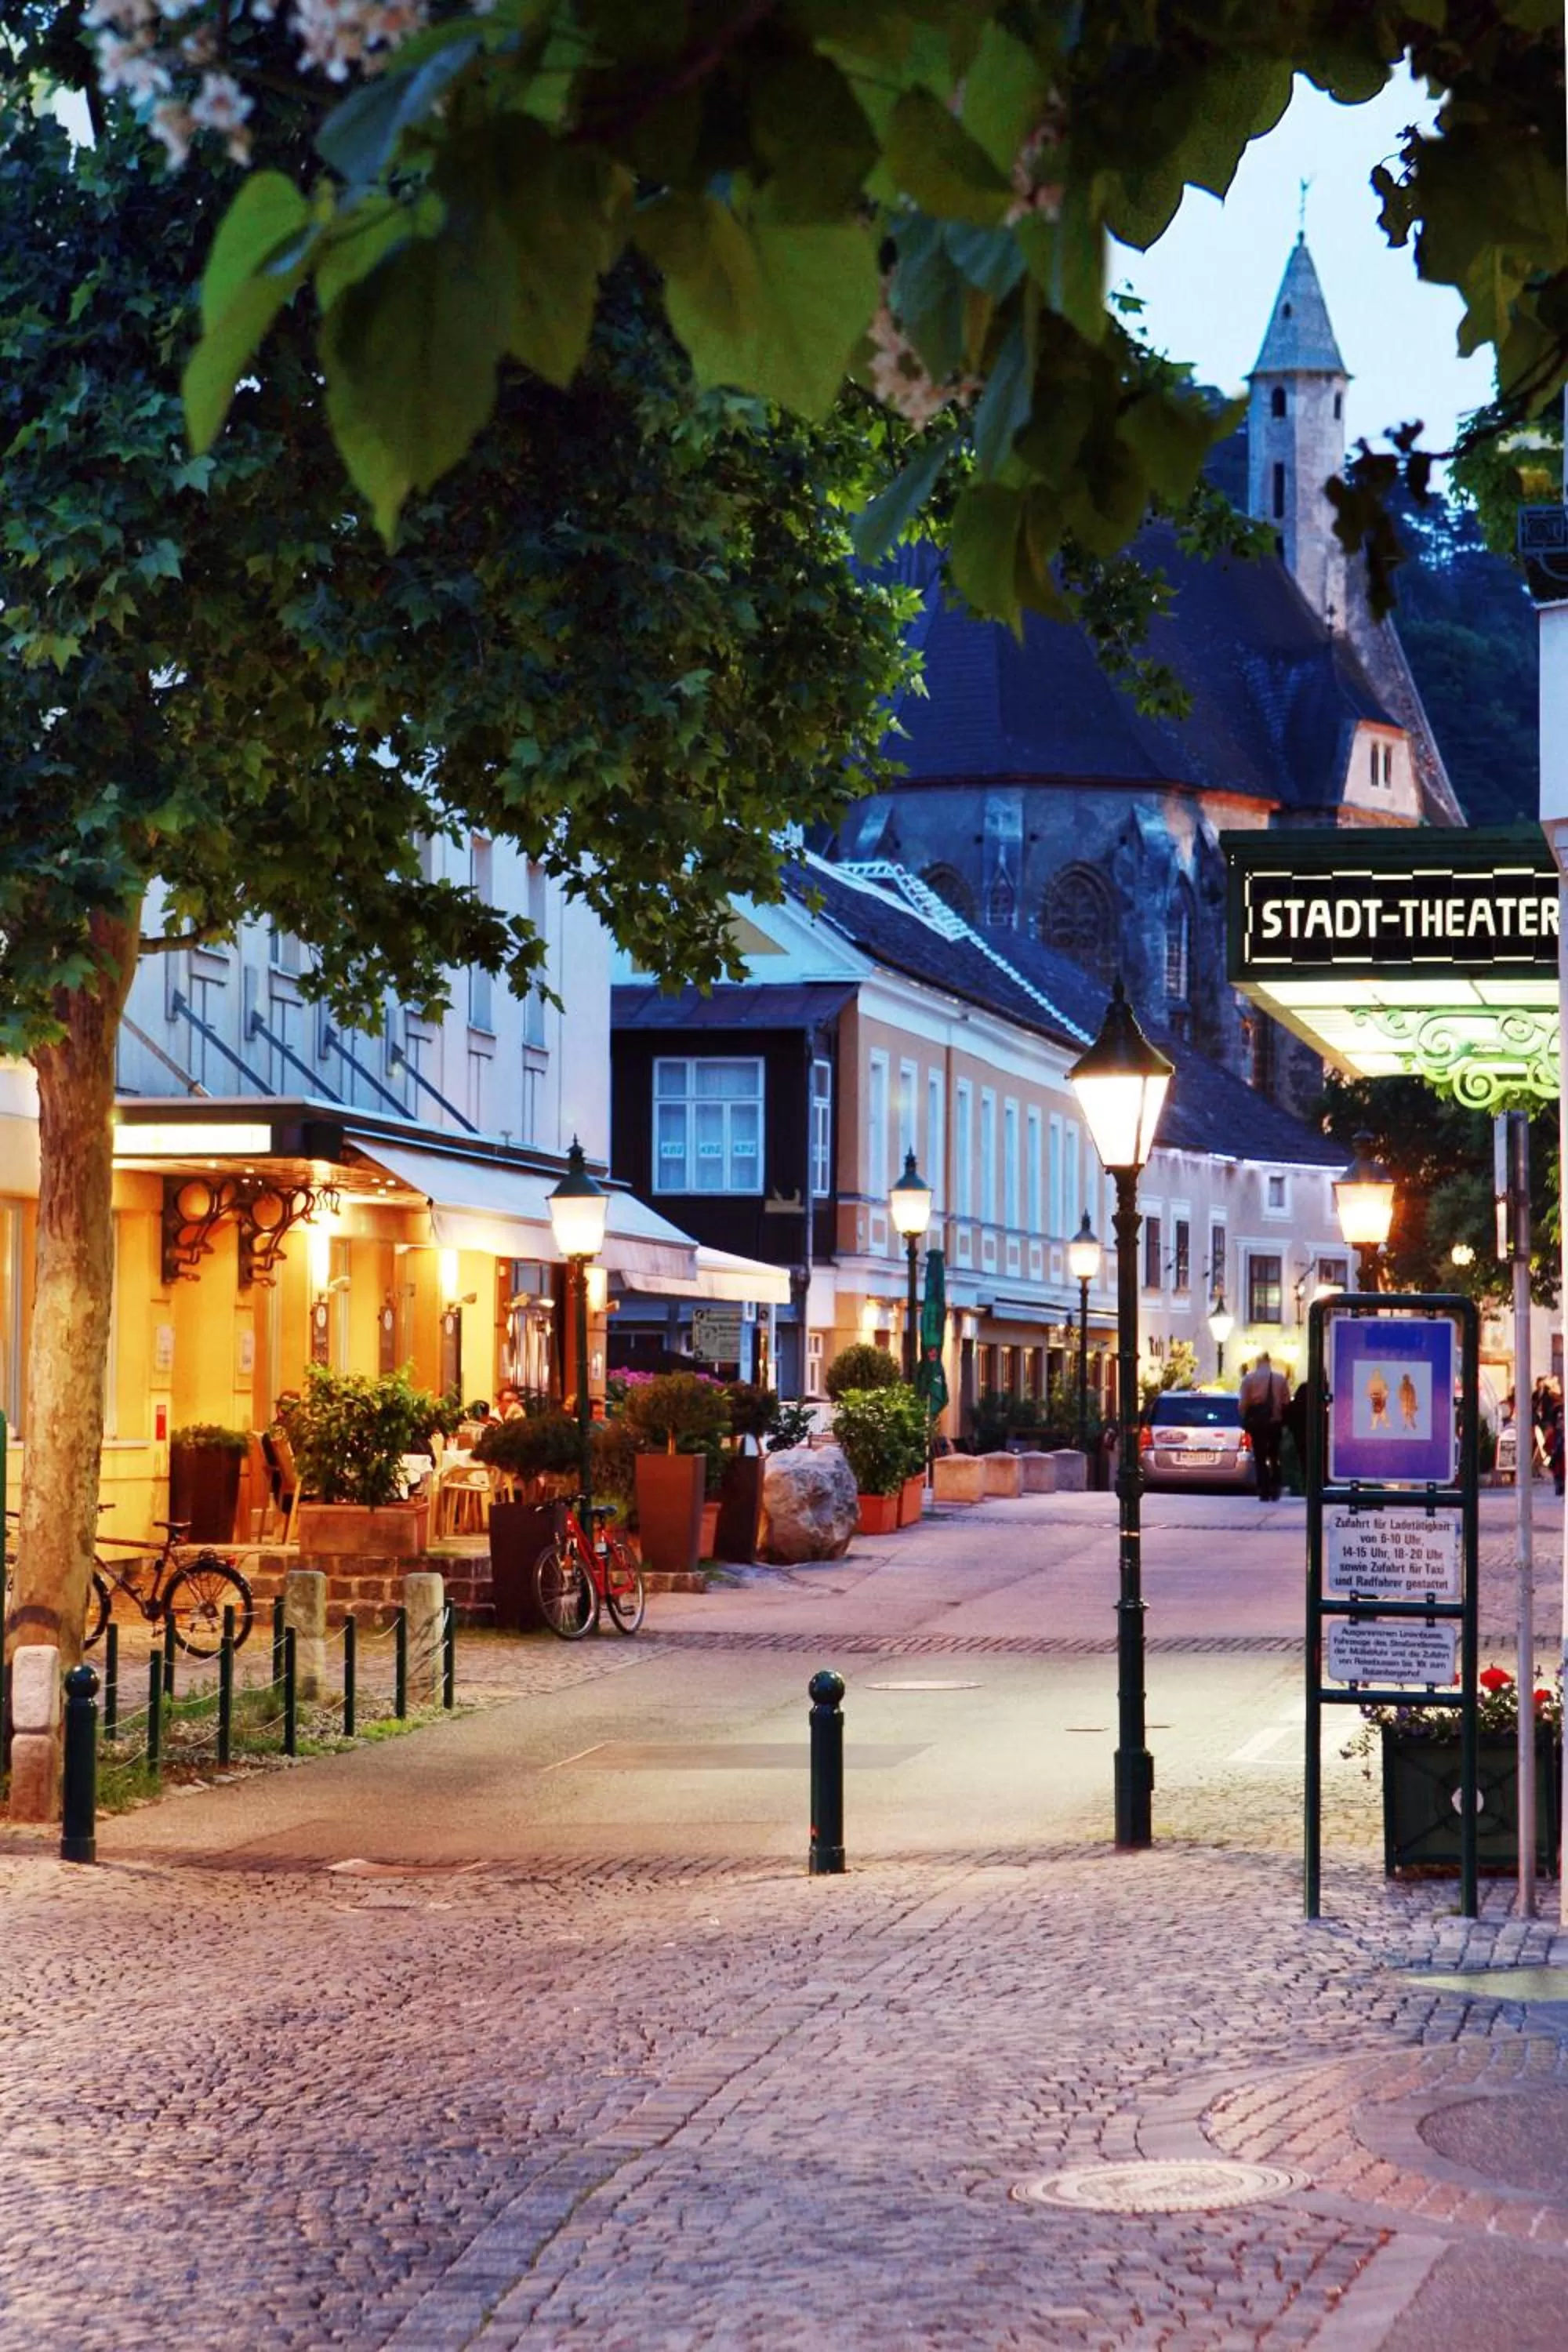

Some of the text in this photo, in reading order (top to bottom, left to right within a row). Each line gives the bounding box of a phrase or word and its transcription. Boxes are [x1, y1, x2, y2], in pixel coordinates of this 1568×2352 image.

[1261, 896, 1559, 938] STADT-THEATER
[1335, 1517, 1450, 1532] Zufahrt für Ladetätigkeit
[1360, 1534, 1377, 1543] von
[1381, 1534, 1401, 1544] 6-10
[1342, 1546, 1367, 1558] 14-15
[1426, 1548, 1443, 1559] Uhr
[1339, 1560, 1444, 1574] sowie Zufahrt für Taxi
[1335, 1576, 1448, 1591] und Radfahrer gestattet
